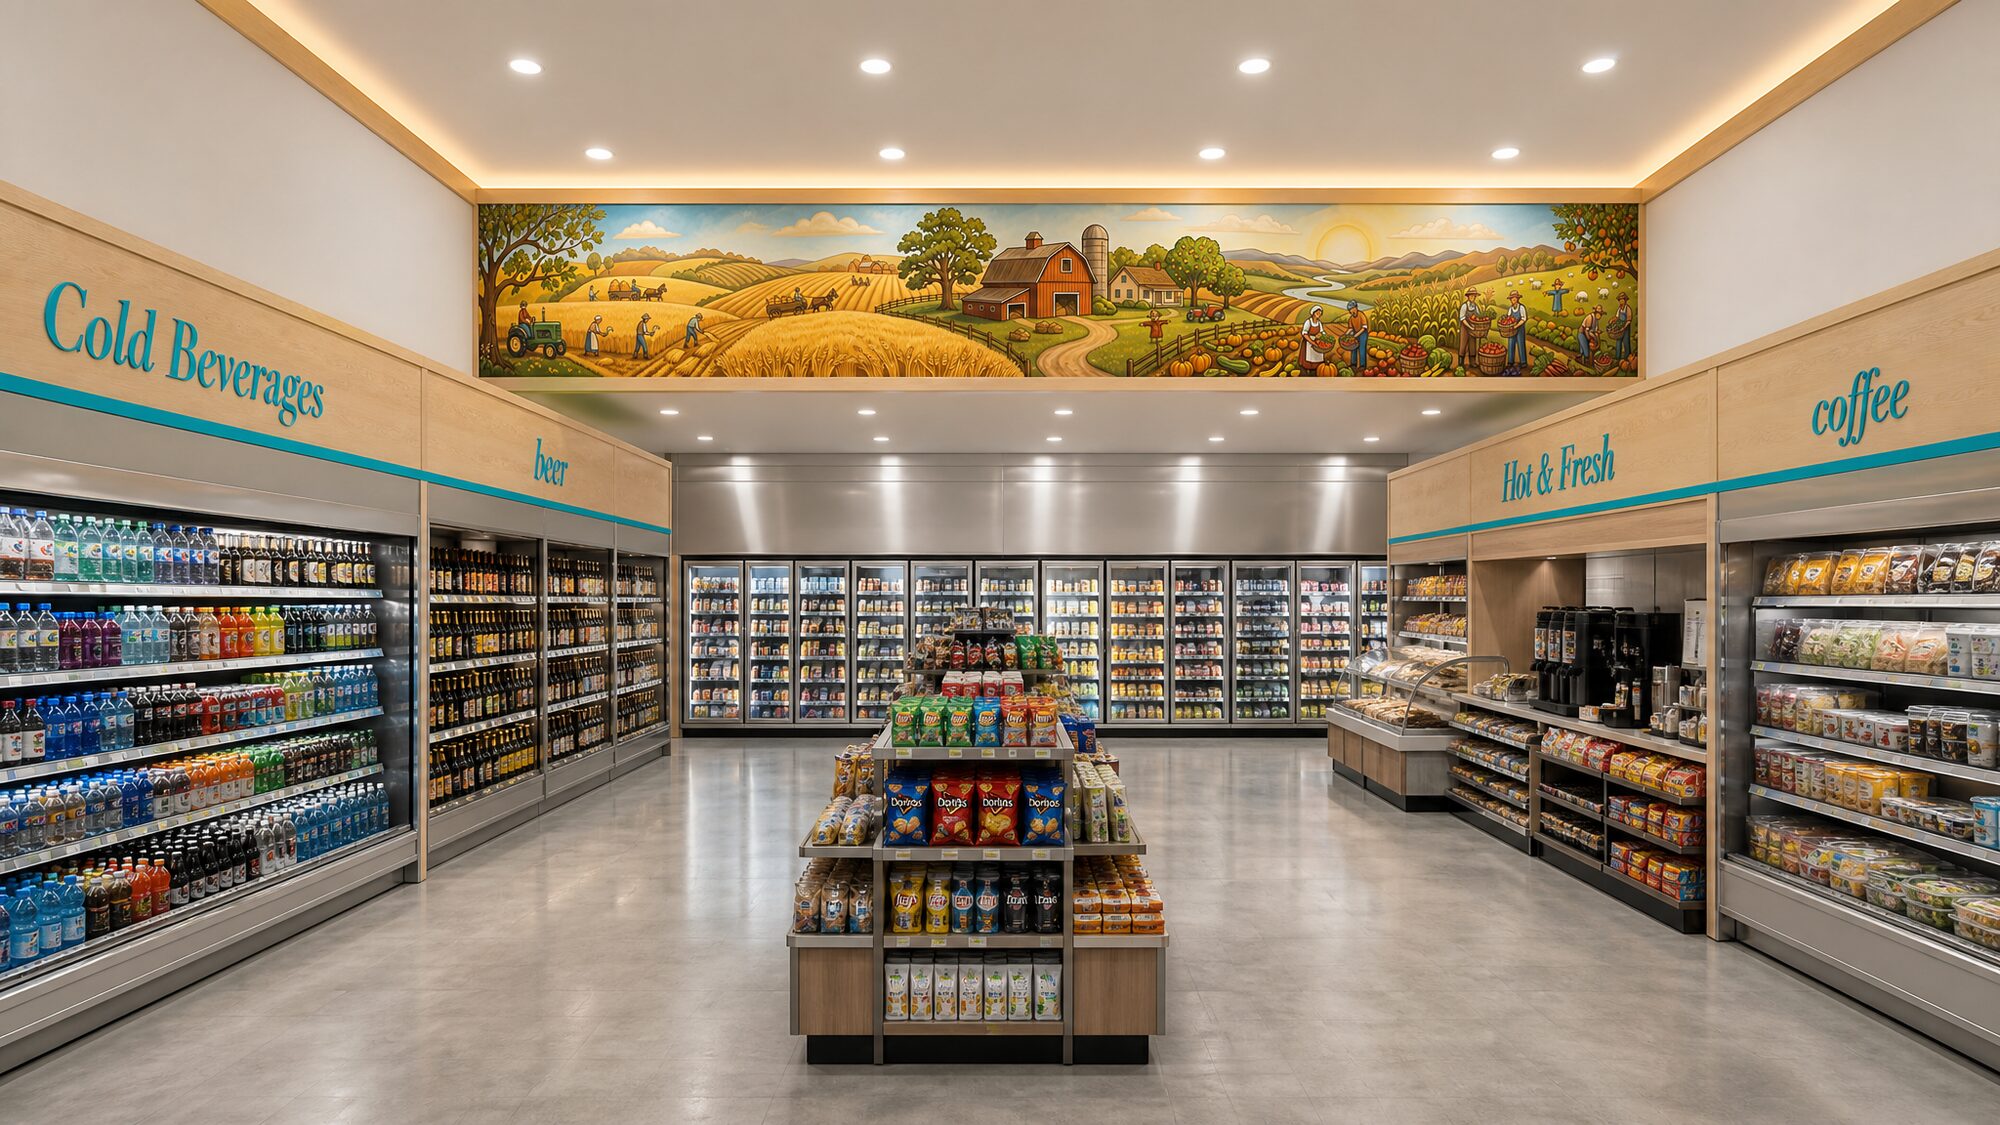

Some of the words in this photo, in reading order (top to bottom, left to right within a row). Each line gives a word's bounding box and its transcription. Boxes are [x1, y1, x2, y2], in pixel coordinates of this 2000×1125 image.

[43, 280, 156, 373] Cold
[165, 317, 326, 428] Beverages
[1810, 366, 1911, 448] coffee
[533, 437, 570, 487] beer
[1500, 461, 1533, 503] Hot
[1536, 452, 1554, 492] &
[1558, 433, 1616, 491] Fresh
